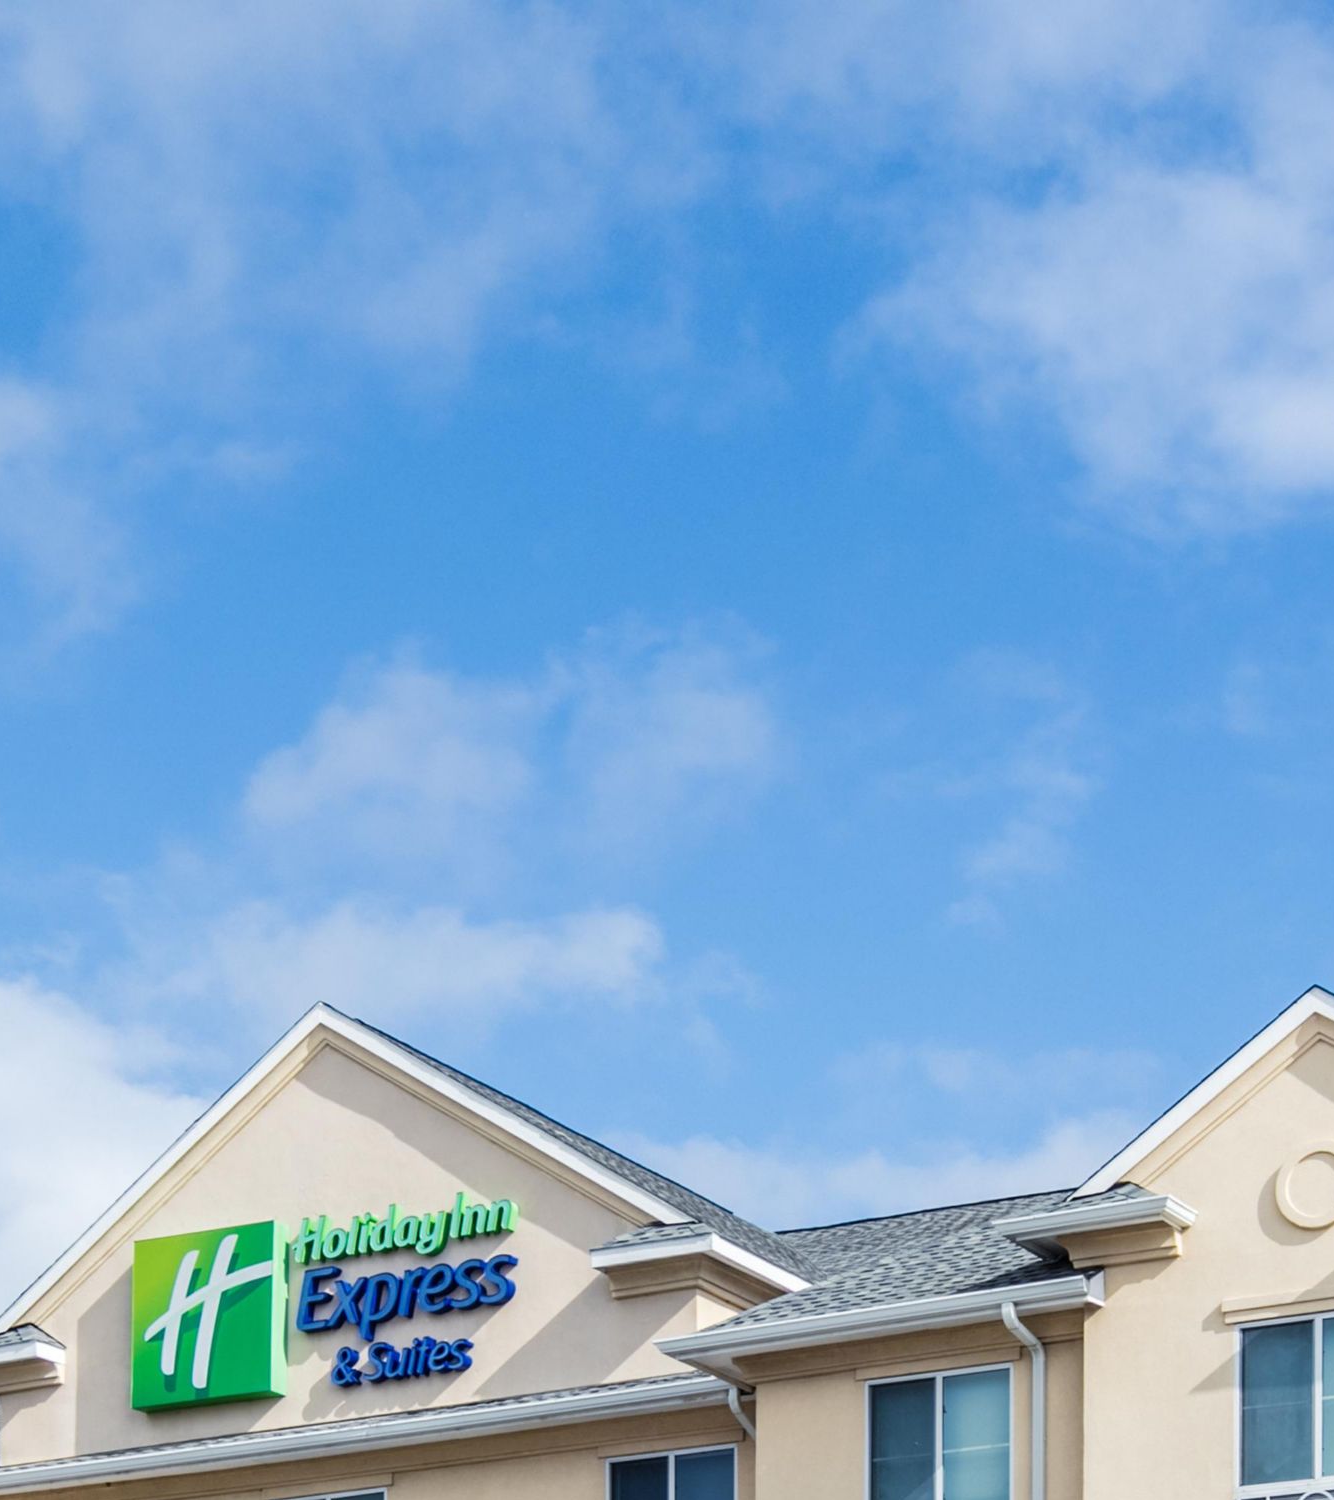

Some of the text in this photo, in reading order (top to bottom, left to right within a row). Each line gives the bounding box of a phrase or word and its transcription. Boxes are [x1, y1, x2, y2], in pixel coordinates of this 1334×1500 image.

[292, 1192, 519, 1264] Holiday Inn
[295, 1254, 519, 1342] Express
[331, 1336, 475, 1387] & Suites
